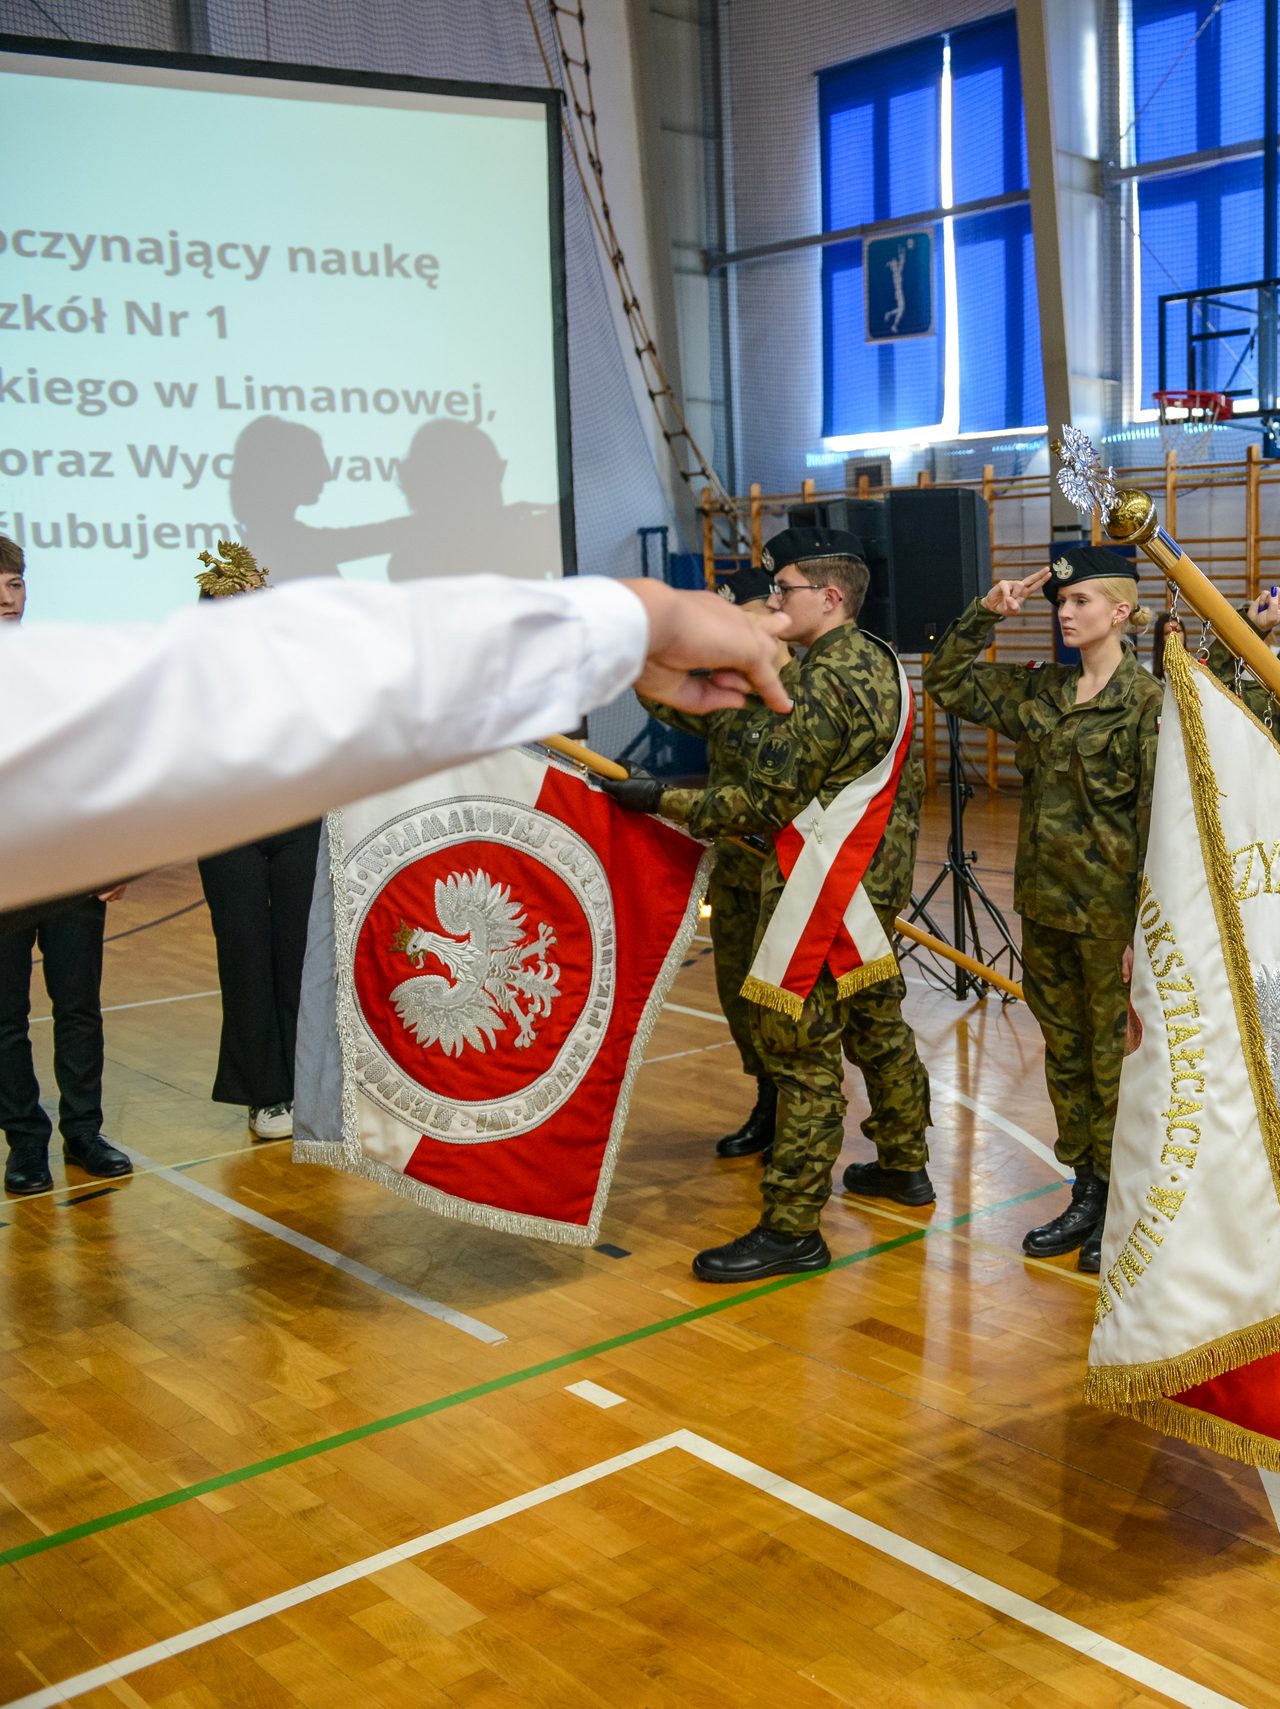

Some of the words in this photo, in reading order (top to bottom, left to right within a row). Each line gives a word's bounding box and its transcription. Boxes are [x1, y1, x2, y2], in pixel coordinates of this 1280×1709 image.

[0, 229, 271, 281] czynający
[287, 243, 440, 289] naukę
[125, 300, 189, 338] Nr
[206, 305, 228, 339] 1
[153, 381, 198, 408] w
[216, 375, 496, 427] Limanowej,
[0, 448, 115, 478] oraz
[1146, 1185, 1186, 1222] W
